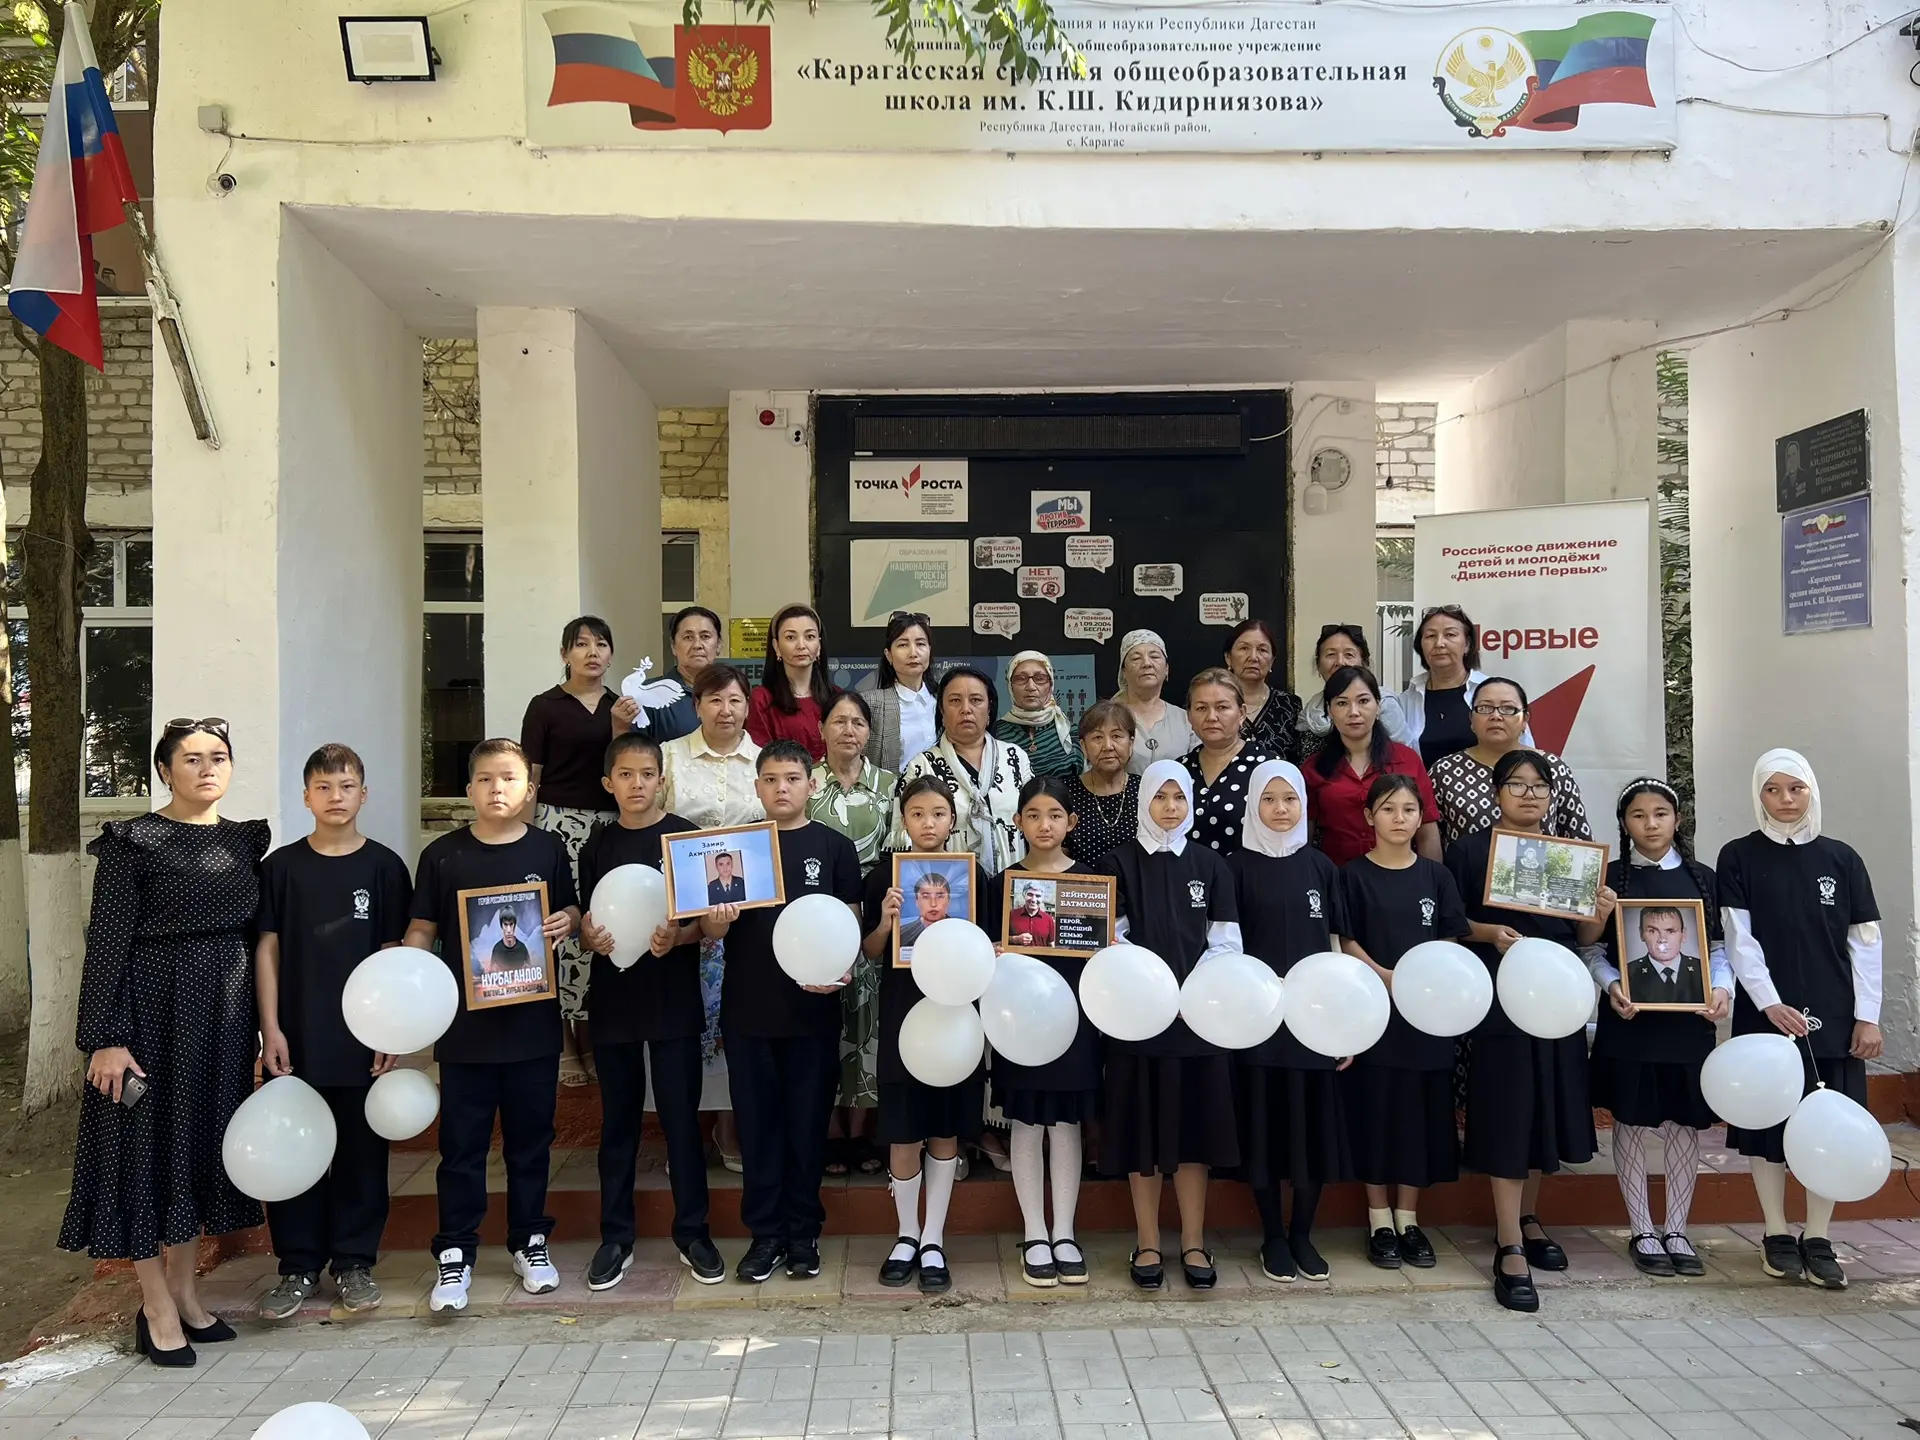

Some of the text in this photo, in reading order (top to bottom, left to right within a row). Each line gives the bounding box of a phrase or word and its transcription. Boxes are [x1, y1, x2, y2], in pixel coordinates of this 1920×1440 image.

[1099, 19, 1107, 29] и
[1112, 19, 1153, 33] науки
[1160, 17, 1245, 33] Республики
[1250, 17, 1316, 31] Дагестан
[1077, 39, 1233, 53] общеобразовательное
[1238, 41, 1322, 54] учреждение
[797, 58, 985, 86] «Карагасская
[1113, 60, 1407, 87] общеобразовательная
[884, 89, 1324, 116] школа им. К.Ш. Кидирниязова»
[980, 121, 1211, 134] Республика Дагестан, Ногайский район,
[1080, 136, 1125, 149] Карагас
[854, 479, 963, 490] ТОЧКА РОСТА
[1057, 498, 1078, 511] МЫ
[1040, 511, 1068, 521] ПРОТИВ
[1046, 517, 1077, 529] ТЕРРОРА
[1442, 538, 1618, 557] Российское движение
[890, 561, 947, 571] НАЦИОНАЛЬНЫЕ
[1457, 556, 1502, 569] детей
[1518, 551, 1600, 565] молодёжи
[914, 571, 947, 580] ПРОЕКТЫ
[1028, 567, 1052, 576] НЕТ
[1450, 565, 1608, 582] «Движение Первых»
[920, 580, 947, 589] РОССИИ
[1060, 891, 1107, 900] ЗЕЙНУДИН
[1060, 900, 1106, 909] БАТМАНОВ
[481, 966, 543, 988] НУРБАГАНДОВ
